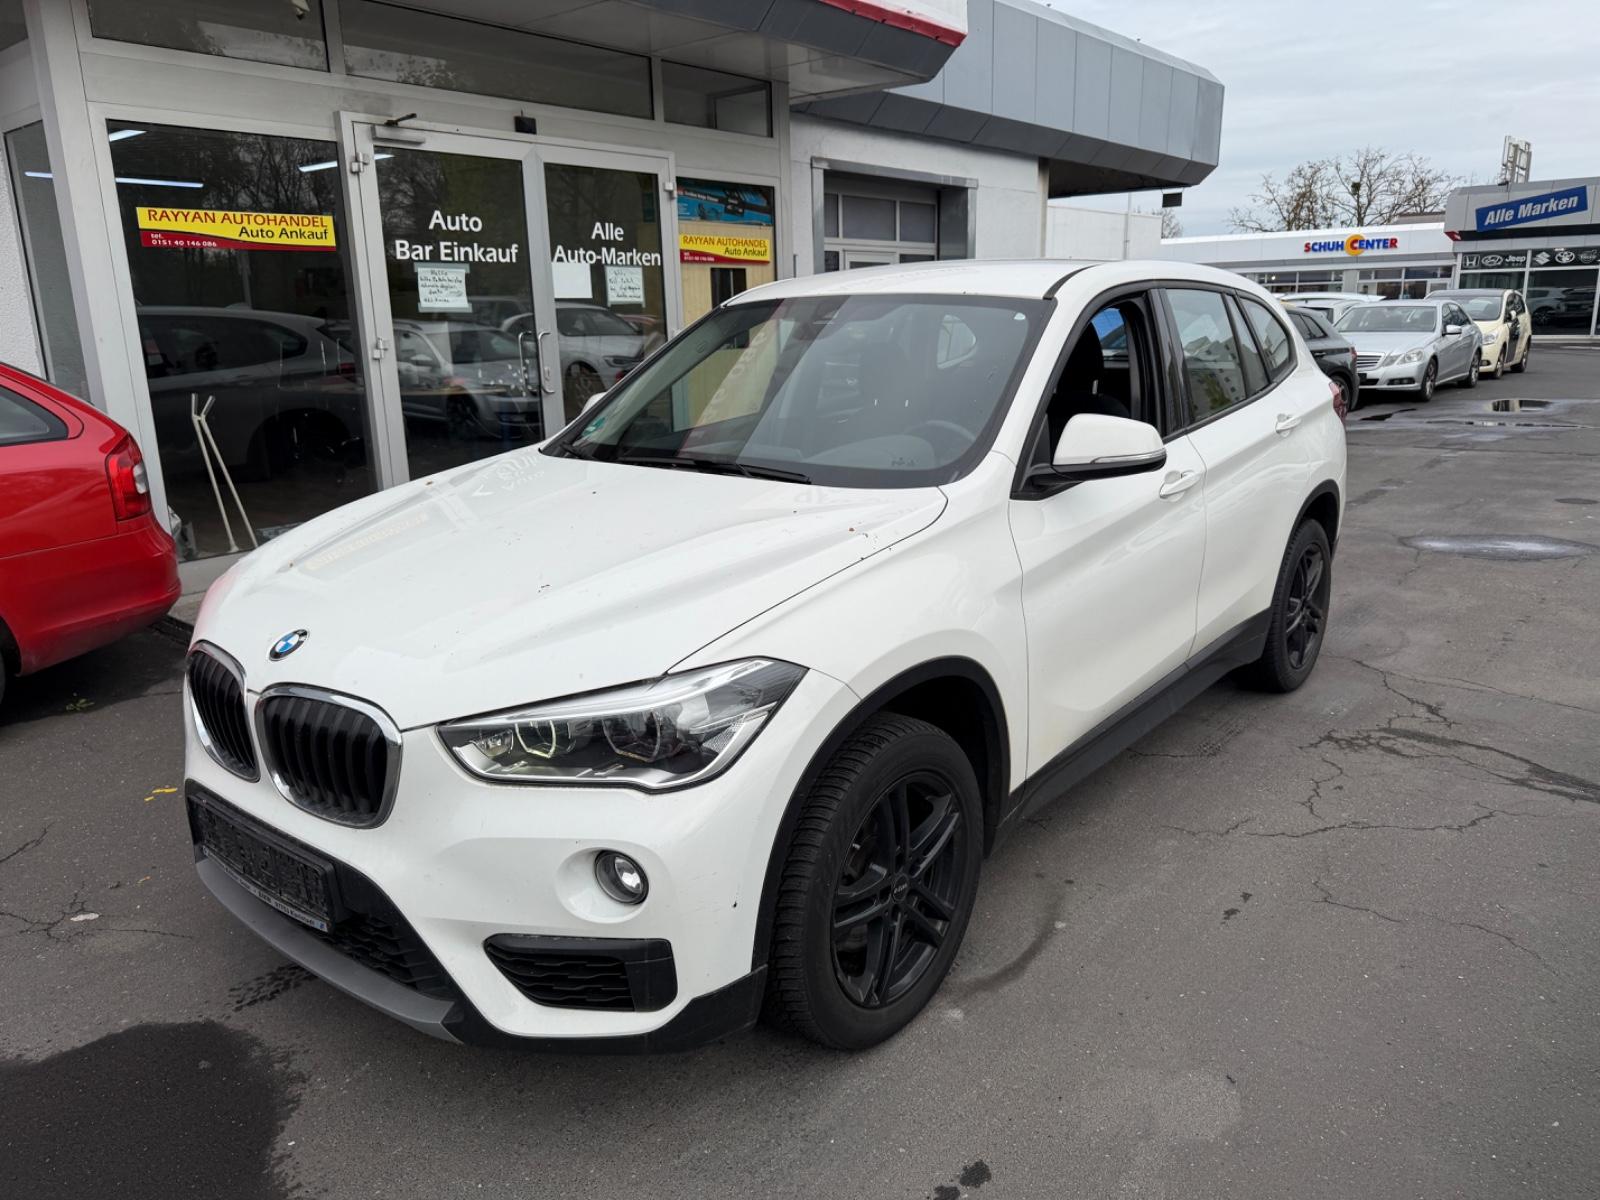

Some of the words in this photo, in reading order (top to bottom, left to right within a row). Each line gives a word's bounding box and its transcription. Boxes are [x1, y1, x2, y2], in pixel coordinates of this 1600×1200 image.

[147, 209, 216, 224] RAYYAN
[220, 212, 328, 228] AUTOHANDEL
[1484, 207, 1514, 226] Alle
[1517, 196, 1579, 219] Marken
[428, 210, 483, 232] Auto
[238, 226, 275, 239] Auto
[278, 227, 329, 240] Ankauf
[591, 222, 624, 241] Alle
[395, 239, 433, 261] Bar
[439, 241, 518, 263] Einkauf
[682, 235, 715, 245] RAYYAN
[716, 237, 767, 248] AUTOHANDEL
[1304, 241, 1344, 253] SCHUH
[1349, 237, 1398, 251] CENTER
[552, 245, 661, 267] Auto-Marken
[724, 247, 742, 256] Auto
[743, 248, 767, 257] Ankauf
